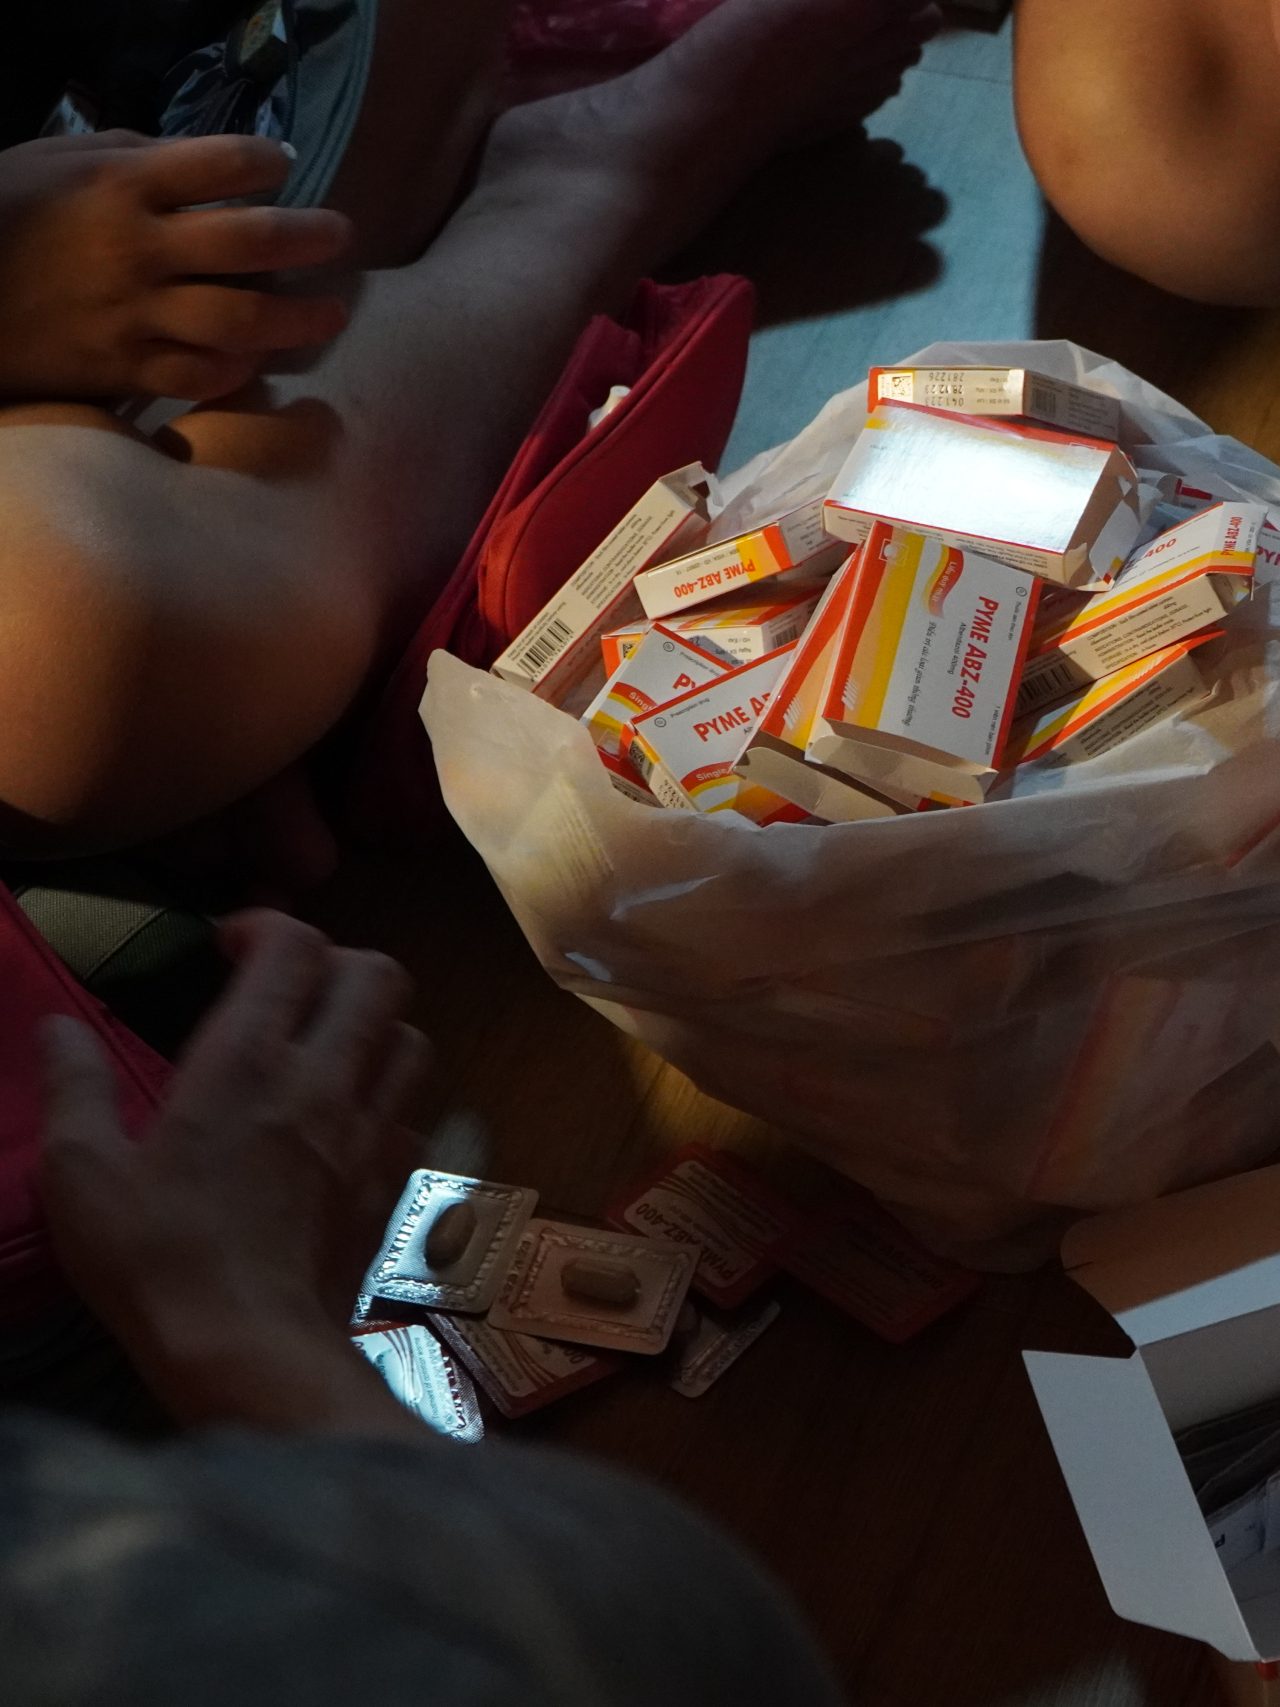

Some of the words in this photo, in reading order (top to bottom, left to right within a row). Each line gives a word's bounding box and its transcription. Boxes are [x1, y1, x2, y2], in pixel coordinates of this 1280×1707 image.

[673, 567, 722, 598] ABZ-400
[722, 558, 757, 582] PYME
[970, 596, 999, 644] PYME
[952, 643, 987, 718] ABZ-400
[693, 706, 750, 742] PYME
